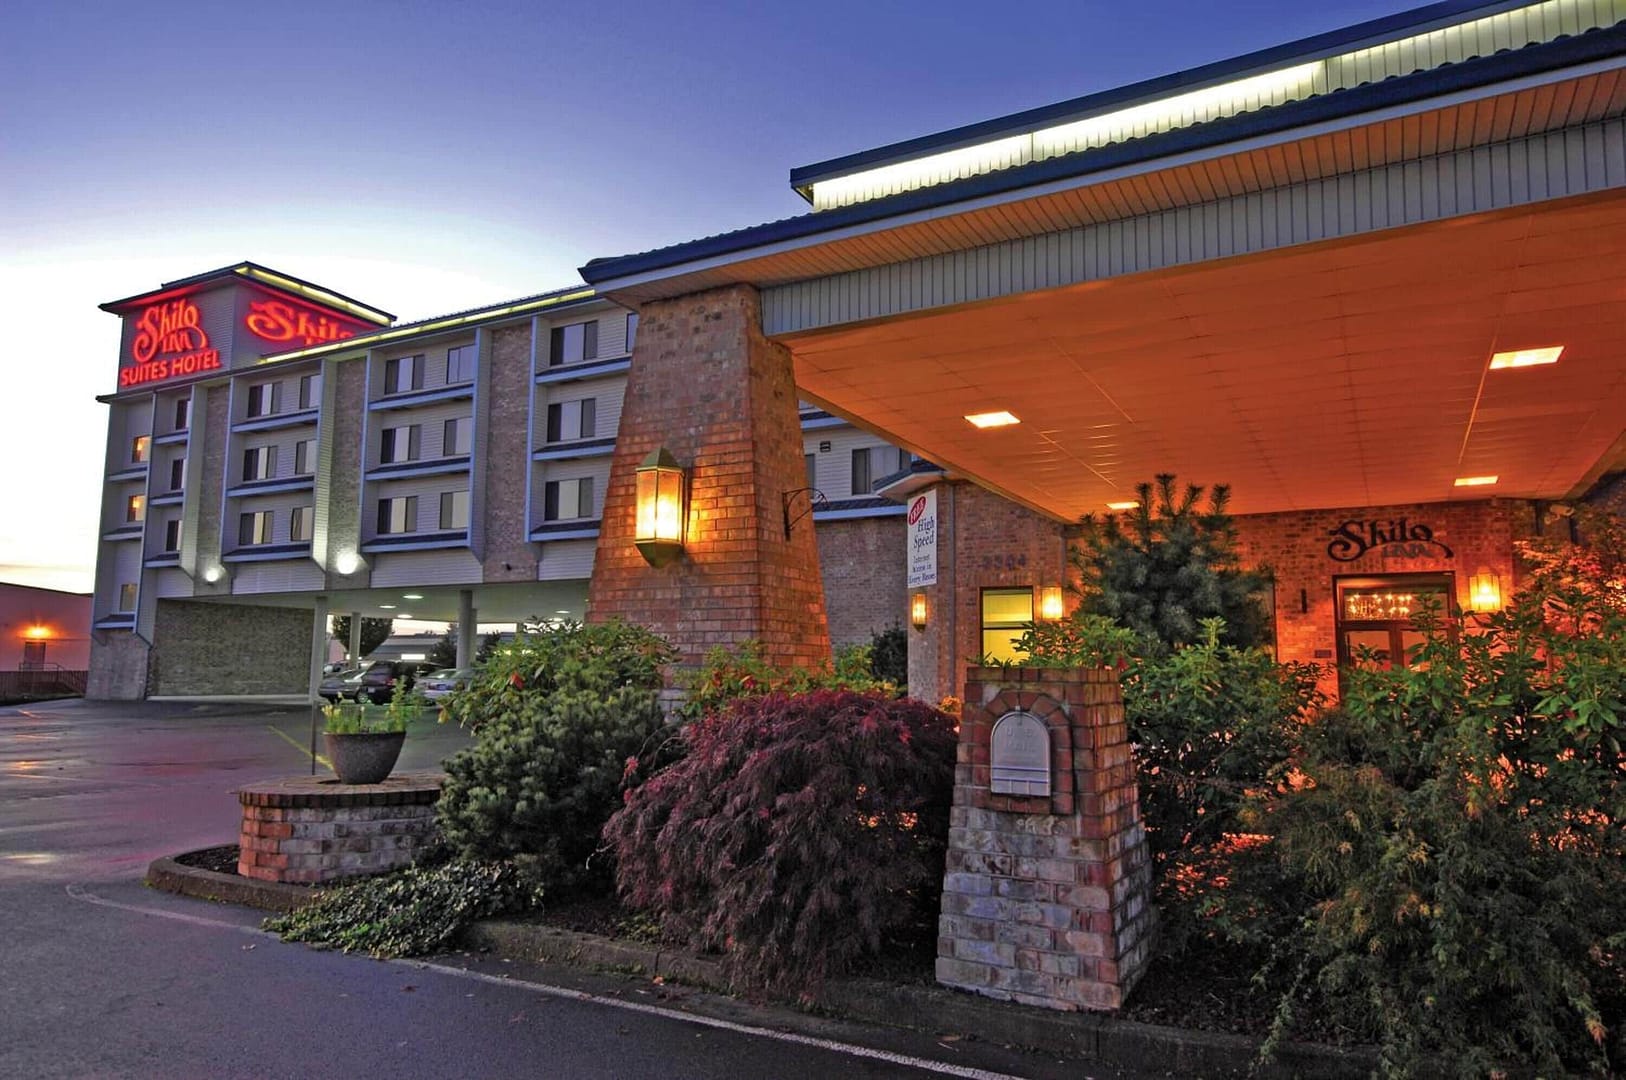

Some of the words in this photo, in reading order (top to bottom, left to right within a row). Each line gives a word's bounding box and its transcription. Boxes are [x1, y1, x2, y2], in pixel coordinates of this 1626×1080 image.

[133, 299, 208, 363] Shilo
[121, 361, 168, 386] SUITES
[171, 350, 221, 376] HOTEL
[914, 531, 935, 552] Speed
[918, 516, 935, 534] High
[1327, 517, 1454, 562] Shilo
